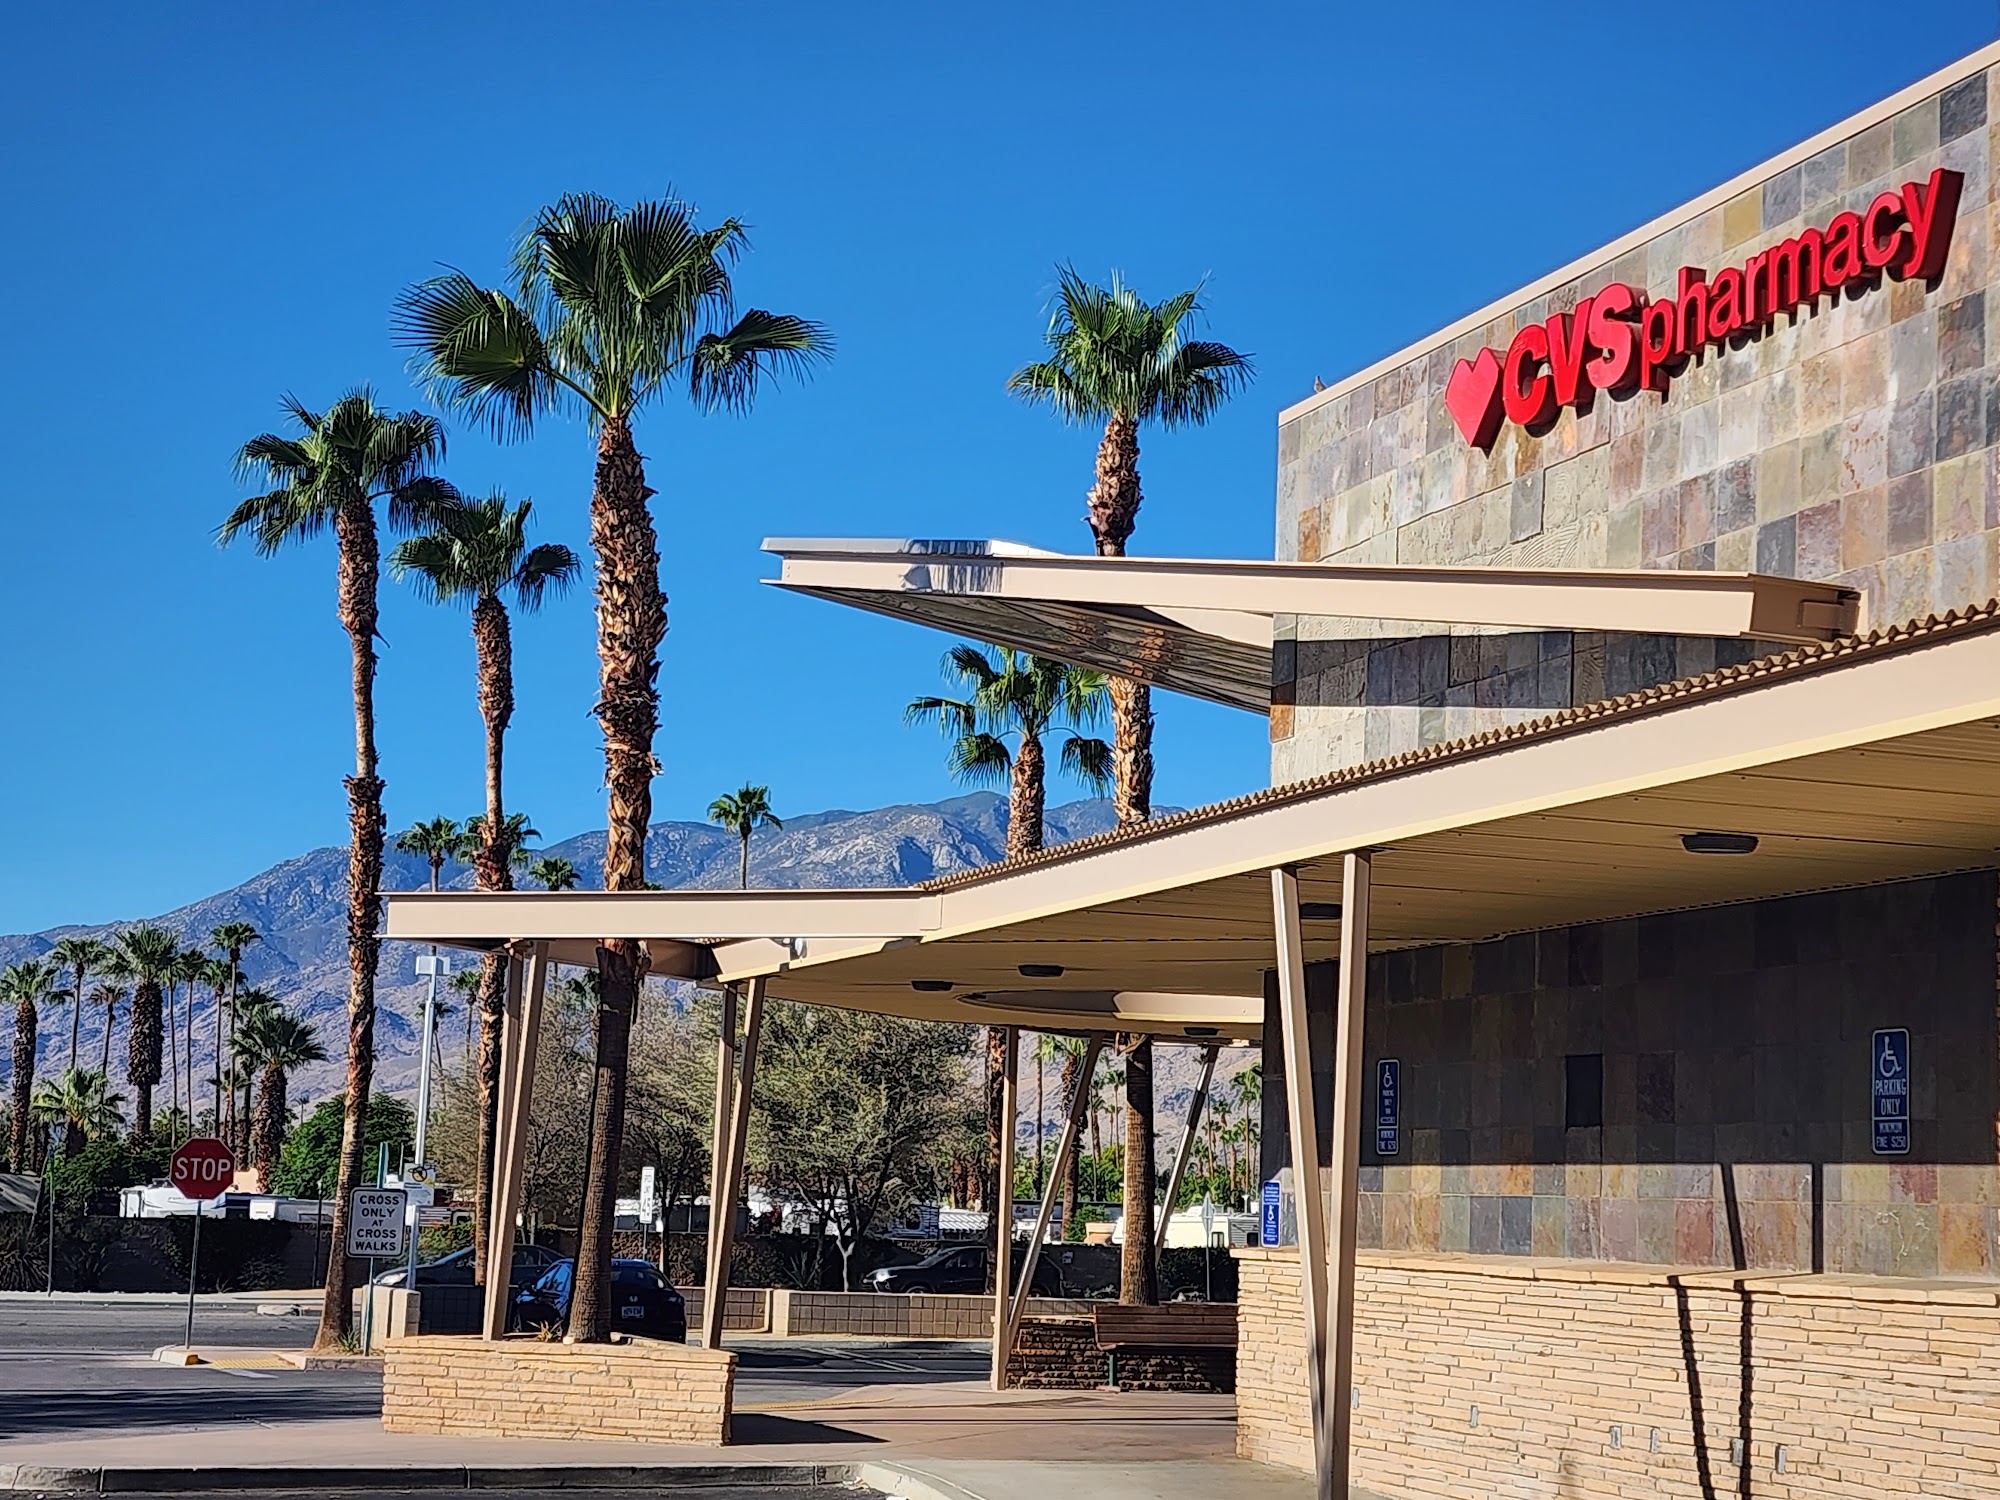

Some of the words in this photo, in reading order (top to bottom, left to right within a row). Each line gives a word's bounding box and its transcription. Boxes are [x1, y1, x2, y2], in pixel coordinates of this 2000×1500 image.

[1502, 282, 1646, 425] CVS
[1641, 167, 1964, 391] pharmacy
[1875, 1078, 1907, 1096] PARKING
[1880, 1098, 1901, 1115] ONLY
[174, 1156, 231, 1181] STOP
[359, 1194, 400, 1205] CROSS
[361, 1207, 396, 1218] ONLY
[371, 1219, 384, 1227] AT
[356, 1228, 397, 1239] CROSS
[355, 1241, 397, 1251] WALKS
